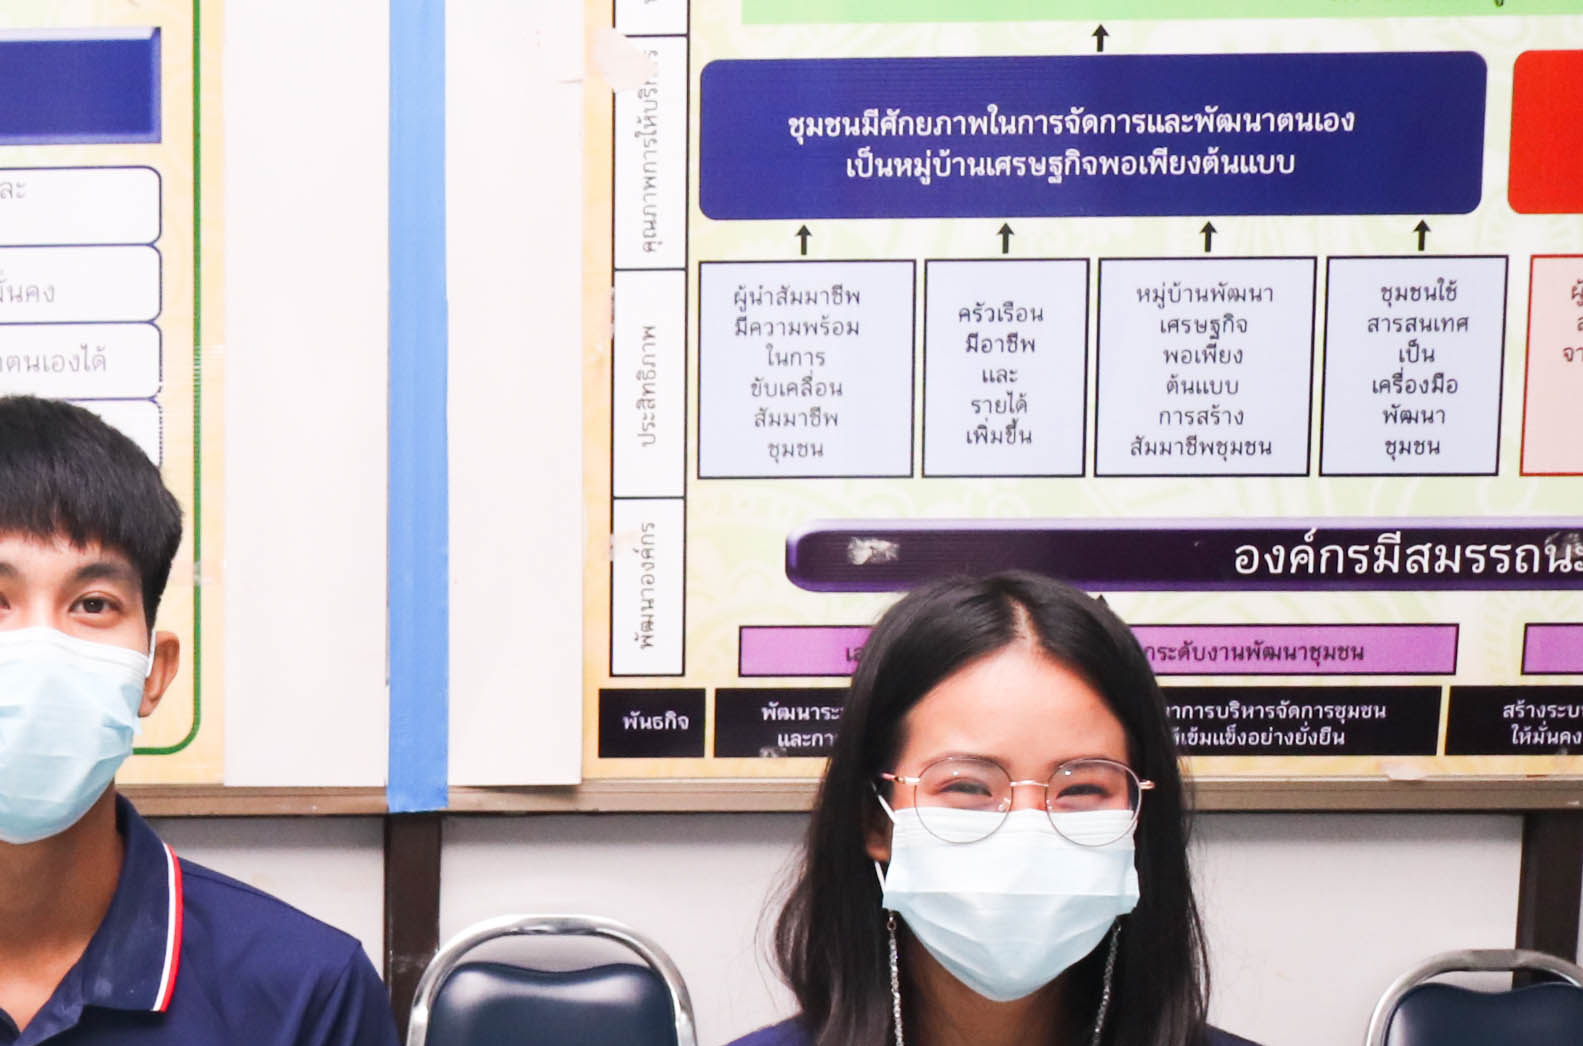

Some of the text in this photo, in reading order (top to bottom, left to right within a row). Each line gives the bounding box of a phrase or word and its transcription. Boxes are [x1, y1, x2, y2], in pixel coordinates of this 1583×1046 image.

[788, 104, 1356, 143] ชุมชนมีศักยภาพในการจัดการและพัฒนาตนเอง
[846, 143, 1296, 186] เป็นหมู่บ้านเศรษฐกิจพอเพียงต้นแบบ
[733, 284, 861, 313] ผู้นำสัมมาชีพ
[1136, 281, 1274, 309] หมู่บ้านพัฒนา
[1381, 276, 1458, 303] ชุมชนใช้
[959, 301, 1044, 323] ครัวเรือน
[1367, 311, 1470, 334] สารสนเทศ
[734, 316, 860, 338] มีความพร้อม
[1160, 312, 1248, 340] เศรษฐกิจ
[965, 332, 1036, 354] มีอาชีพ
[1163, 343, 1244, 366] พอเพียง
[1398, 339, 1436, 365] เป็น
[766, 343, 826, 368] ในการ
[637, 325, 657, 447] ประสิทธิภาพ
[751, 369, 844, 398] ขับเคลื่อน
[981, 367, 1019, 384] และ
[1166, 374, 1239, 396] ต้นแบบ
[1372, 368, 1459, 396] เครื่องมือ
[971, 391, 1028, 415] รายได้
[1159, 404, 1245, 426] การสร้าง
[1382, 404, 1446, 426] พัฒนา
[754, 406, 839, 429] สัมมาชีพ
[966, 417, 1033, 447] เพิ่มขึ้น
[767, 441, 824, 465] ชุมชน
[1130, 436, 1273, 462] สัมมาชีพชุมชน
[1385, 437, 1441, 462] ชุมชน
[632, 522, 656, 650] พัฒนาองค์กร
[622, 710, 689, 731] พันธกิจ
[761, 701, 843, 721] พัฒนาระ
[1503, 699, 1583, 719] สร้างระบ
[777, 731, 837, 748] และกา
